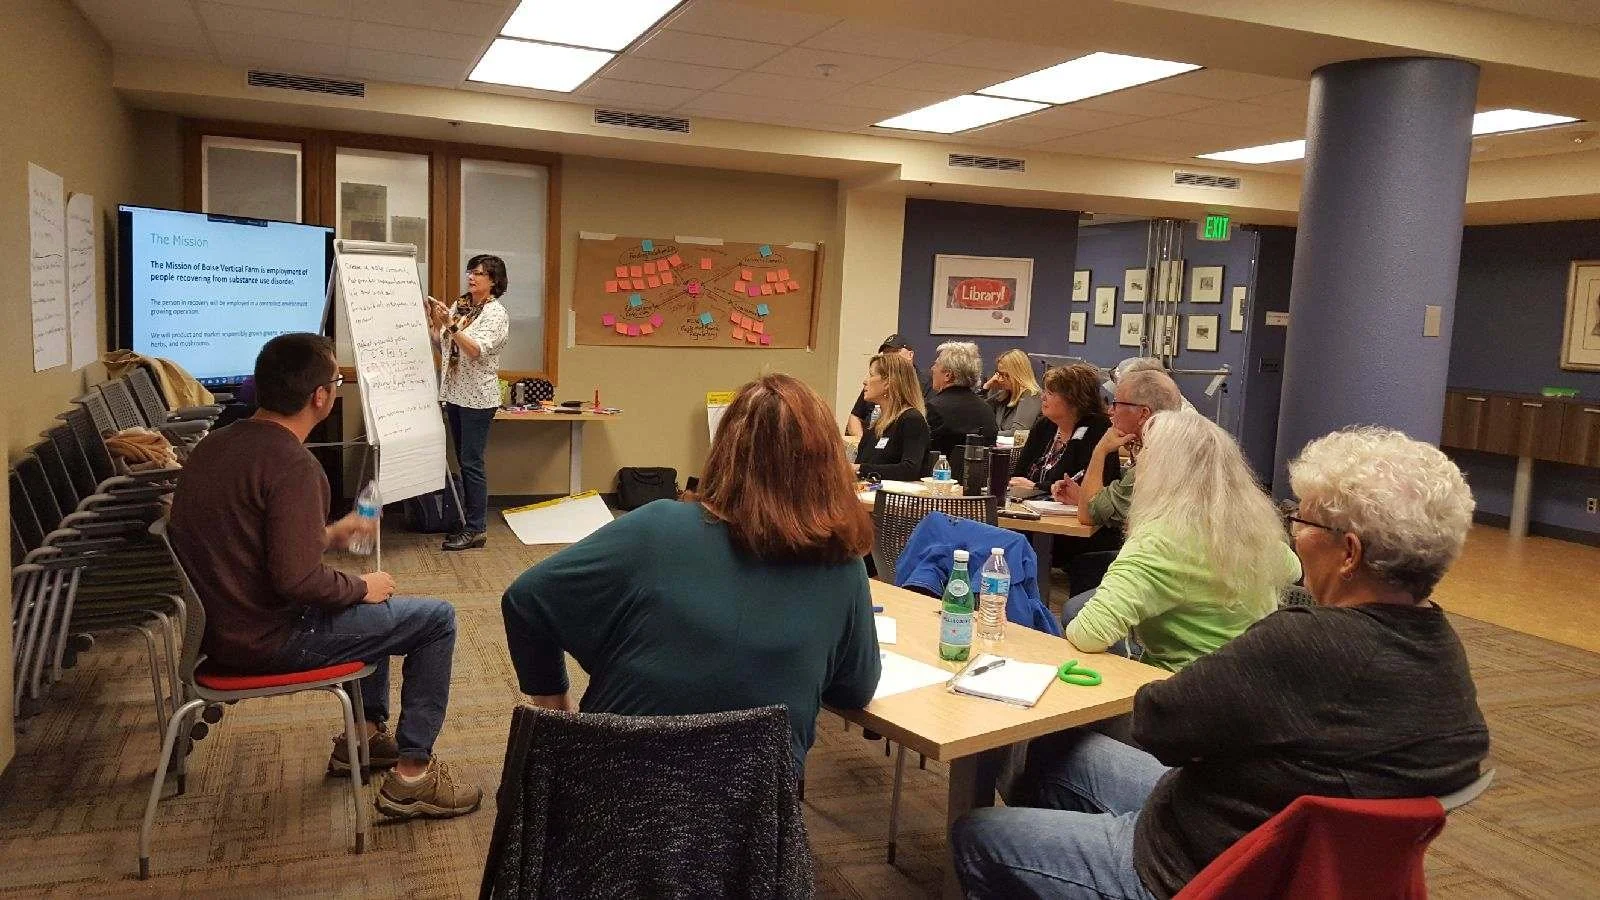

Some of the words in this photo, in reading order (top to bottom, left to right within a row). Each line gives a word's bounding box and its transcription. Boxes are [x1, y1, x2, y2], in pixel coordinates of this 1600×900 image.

[1205, 216, 1229, 238] EXIT
[150, 233, 170, 245] The
[173, 235, 209, 247] Mission
[150, 260, 164, 269] The
[165, 261, 192, 270] Mission
[193, 262, 201, 271] of
[220, 264, 244, 273] Vertical
[244, 265, 260, 273] Farm
[260, 266, 266, 274] is
[150, 272, 175, 282] people
[176, 275, 212, 284] recovering
[212, 275, 228, 283] from
[229, 275, 259, 284] substance
[961, 284, 1006, 304] Library!
[150, 298, 161, 306] The
